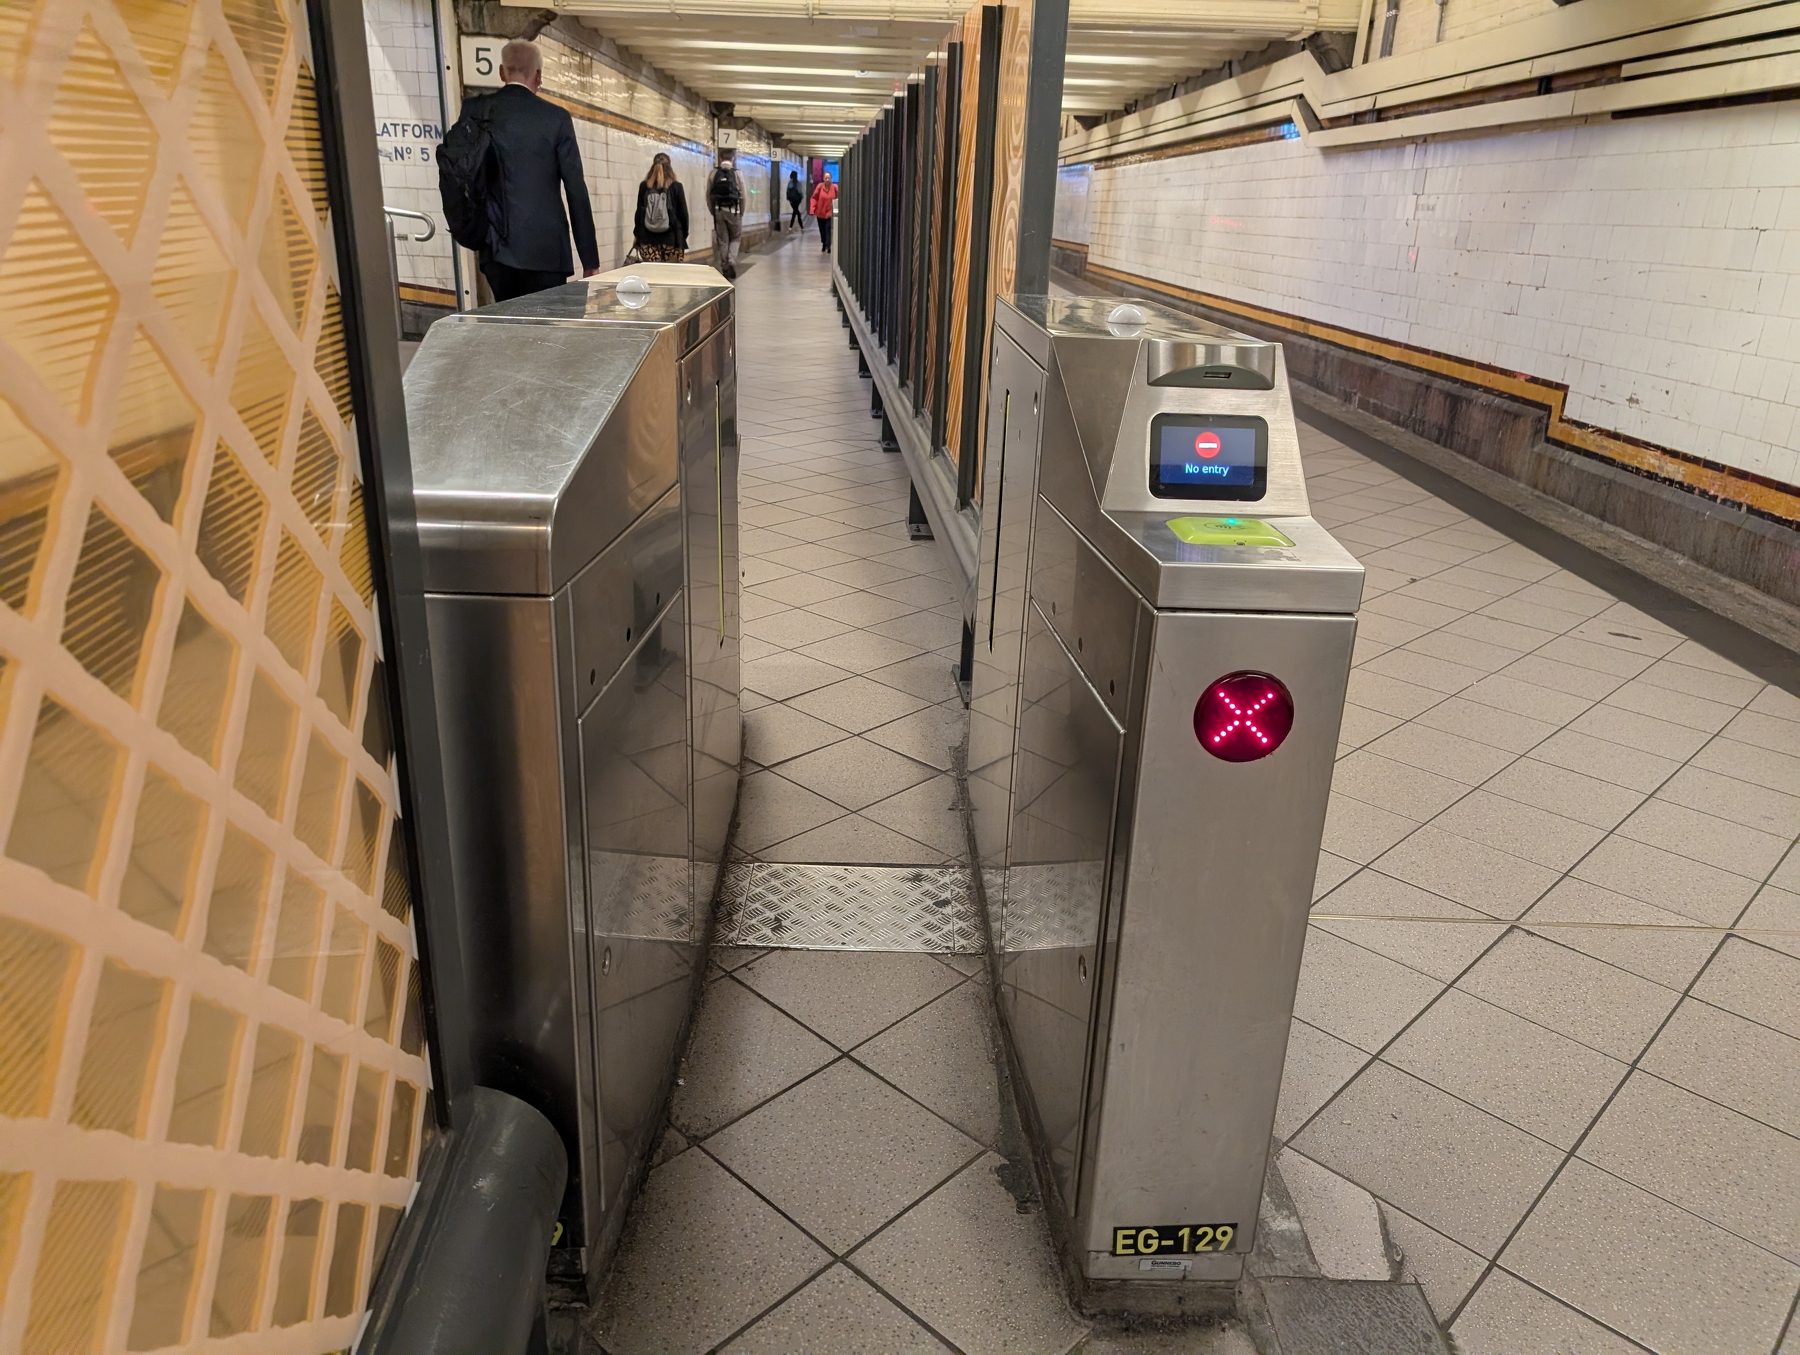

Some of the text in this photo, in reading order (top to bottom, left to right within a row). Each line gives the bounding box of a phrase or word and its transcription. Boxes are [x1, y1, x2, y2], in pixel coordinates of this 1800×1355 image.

[476, 47, 493, 75] 5
[723, 132, 731, 143] 7
[420, 147, 430, 162] 5
[772, 151, 778, 159] 9
[1185, 463, 1230, 477] No entry
[1115, 1226, 1234, 1254] EG-129
